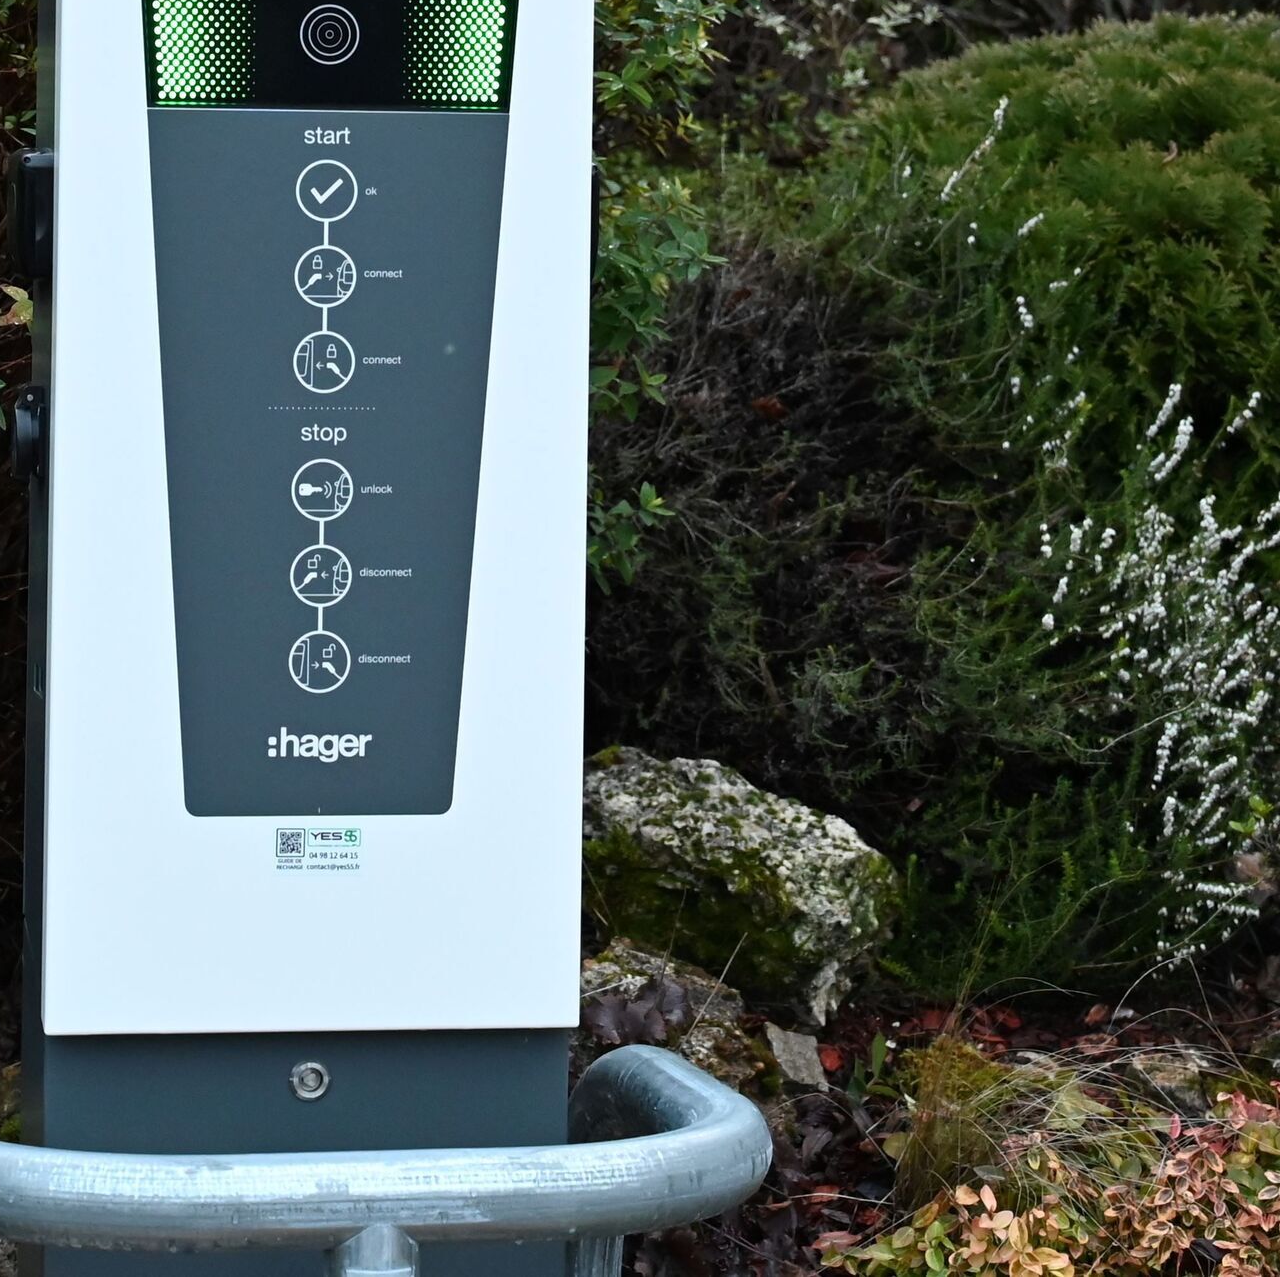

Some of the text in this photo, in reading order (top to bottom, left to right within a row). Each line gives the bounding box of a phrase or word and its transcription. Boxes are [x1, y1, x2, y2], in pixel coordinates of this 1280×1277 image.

[303, 126, 351, 145] start
[364, 186, 377, 196] ok
[364, 268, 403, 279] connect
[362, 354, 401, 365] connect
[300, 423, 347, 445] stop
[360, 483, 393, 494] unlock
[359, 567, 412, 578] disconnect
[358, 653, 411, 664] disconnect
